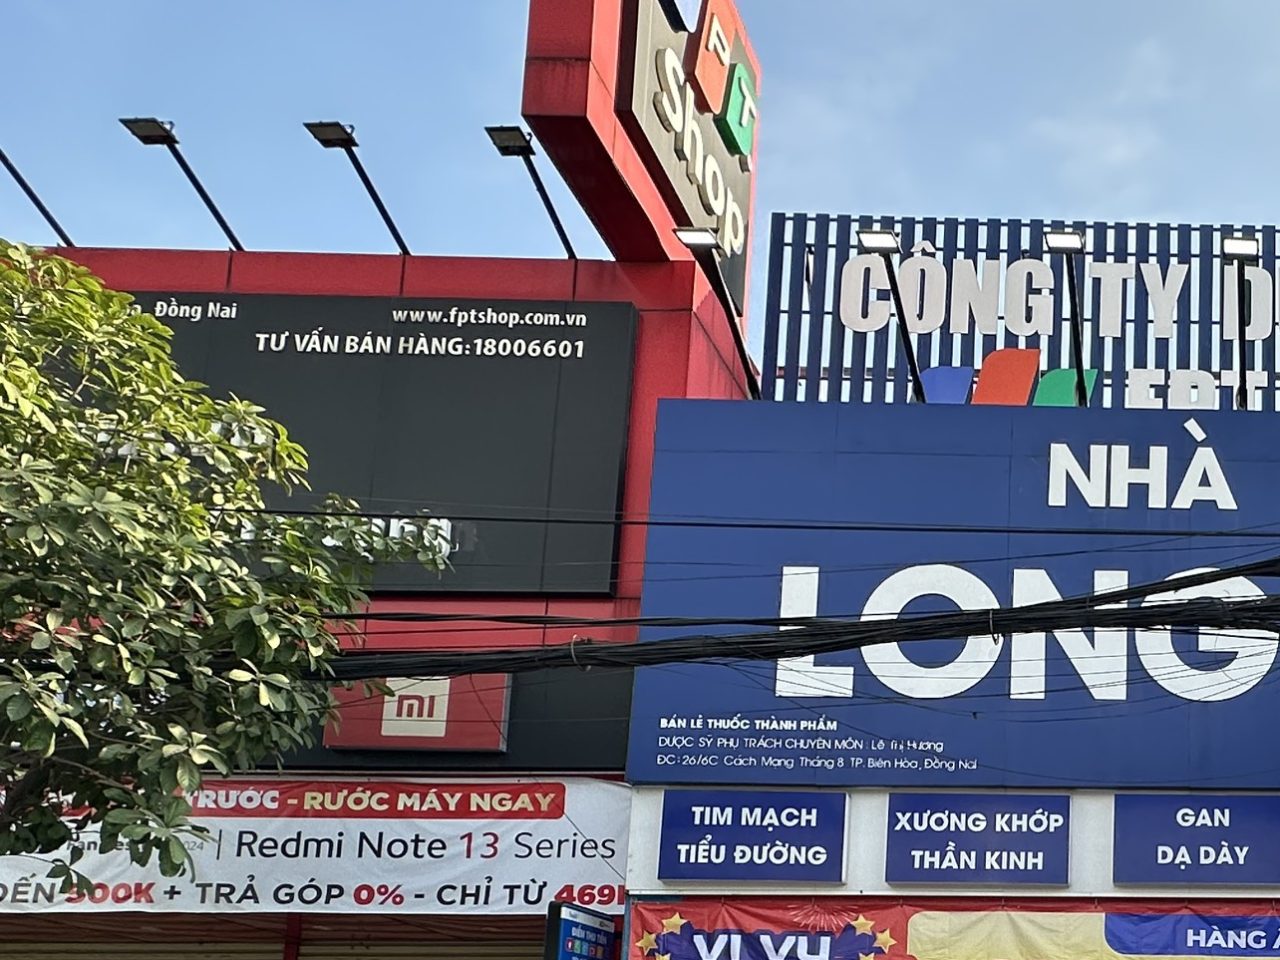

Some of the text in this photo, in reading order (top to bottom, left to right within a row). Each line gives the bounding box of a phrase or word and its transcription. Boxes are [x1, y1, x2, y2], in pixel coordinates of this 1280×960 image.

[840, 240, 1055, 337] CÔNG
[1089, 262, 1189, 339] TY
[154, 297, 201, 321] Đồng
[207, 301, 238, 319] Nai
[393, 306, 588, 328] www.fptshop.com.vn
[256, 331, 287, 353] TƯ
[294, 326, 339, 354] VẤN
[344, 330, 391, 355] BÁN
[1048, 418, 1238, 510] NHÀ
[774, 563, 1280, 702] LONG
[660, 713, 687, 729] BÁN
[707, 713, 751, 729] THUỐC
[755, 715, 798, 731] THÀNH
[658, 736, 694, 749] DƯỢC
[717, 737, 740, 750] PHỤ
[744, 734, 782, 749] TRÁCH
[784, 736, 832, 750] CHUYÊN
[724, 754, 757, 767] Cách
[761, 756, 794, 770] Mạng
[800, 755, 835, 769] Tháng
[837, 757, 845, 767] 8
[867, 757, 892, 769] Biên
[924, 755, 956, 771] Đồng
[958, 758, 978, 770] Nai
[303, 786, 390, 812] RƯỚC
[397, 789, 461, 812] MÁY
[470, 791, 556, 812] NGAY
[691, 806, 818, 832] TIM MẠCH
[894, 809, 1064, 833] XƯƠNG KHỚP
[1175, 808, 1230, 828] GAN
[235, 829, 616, 859] Redmi Note 13 Series
[676, 834, 828, 866] TIỂU ĐƯỜNG
[910, 841, 1044, 871] THẦN KINH
[1156, 842, 1250, 870] DẠ DÀY
[195, 874, 261, 904] TRẢ
[272, 878, 345, 905] GÓP
[353, 883, 405, 906] 0%
[436, 876, 492, 906] CHỈ
[503, 878, 548, 905] TỪ
[1186, 924, 1267, 949] HÀNG
